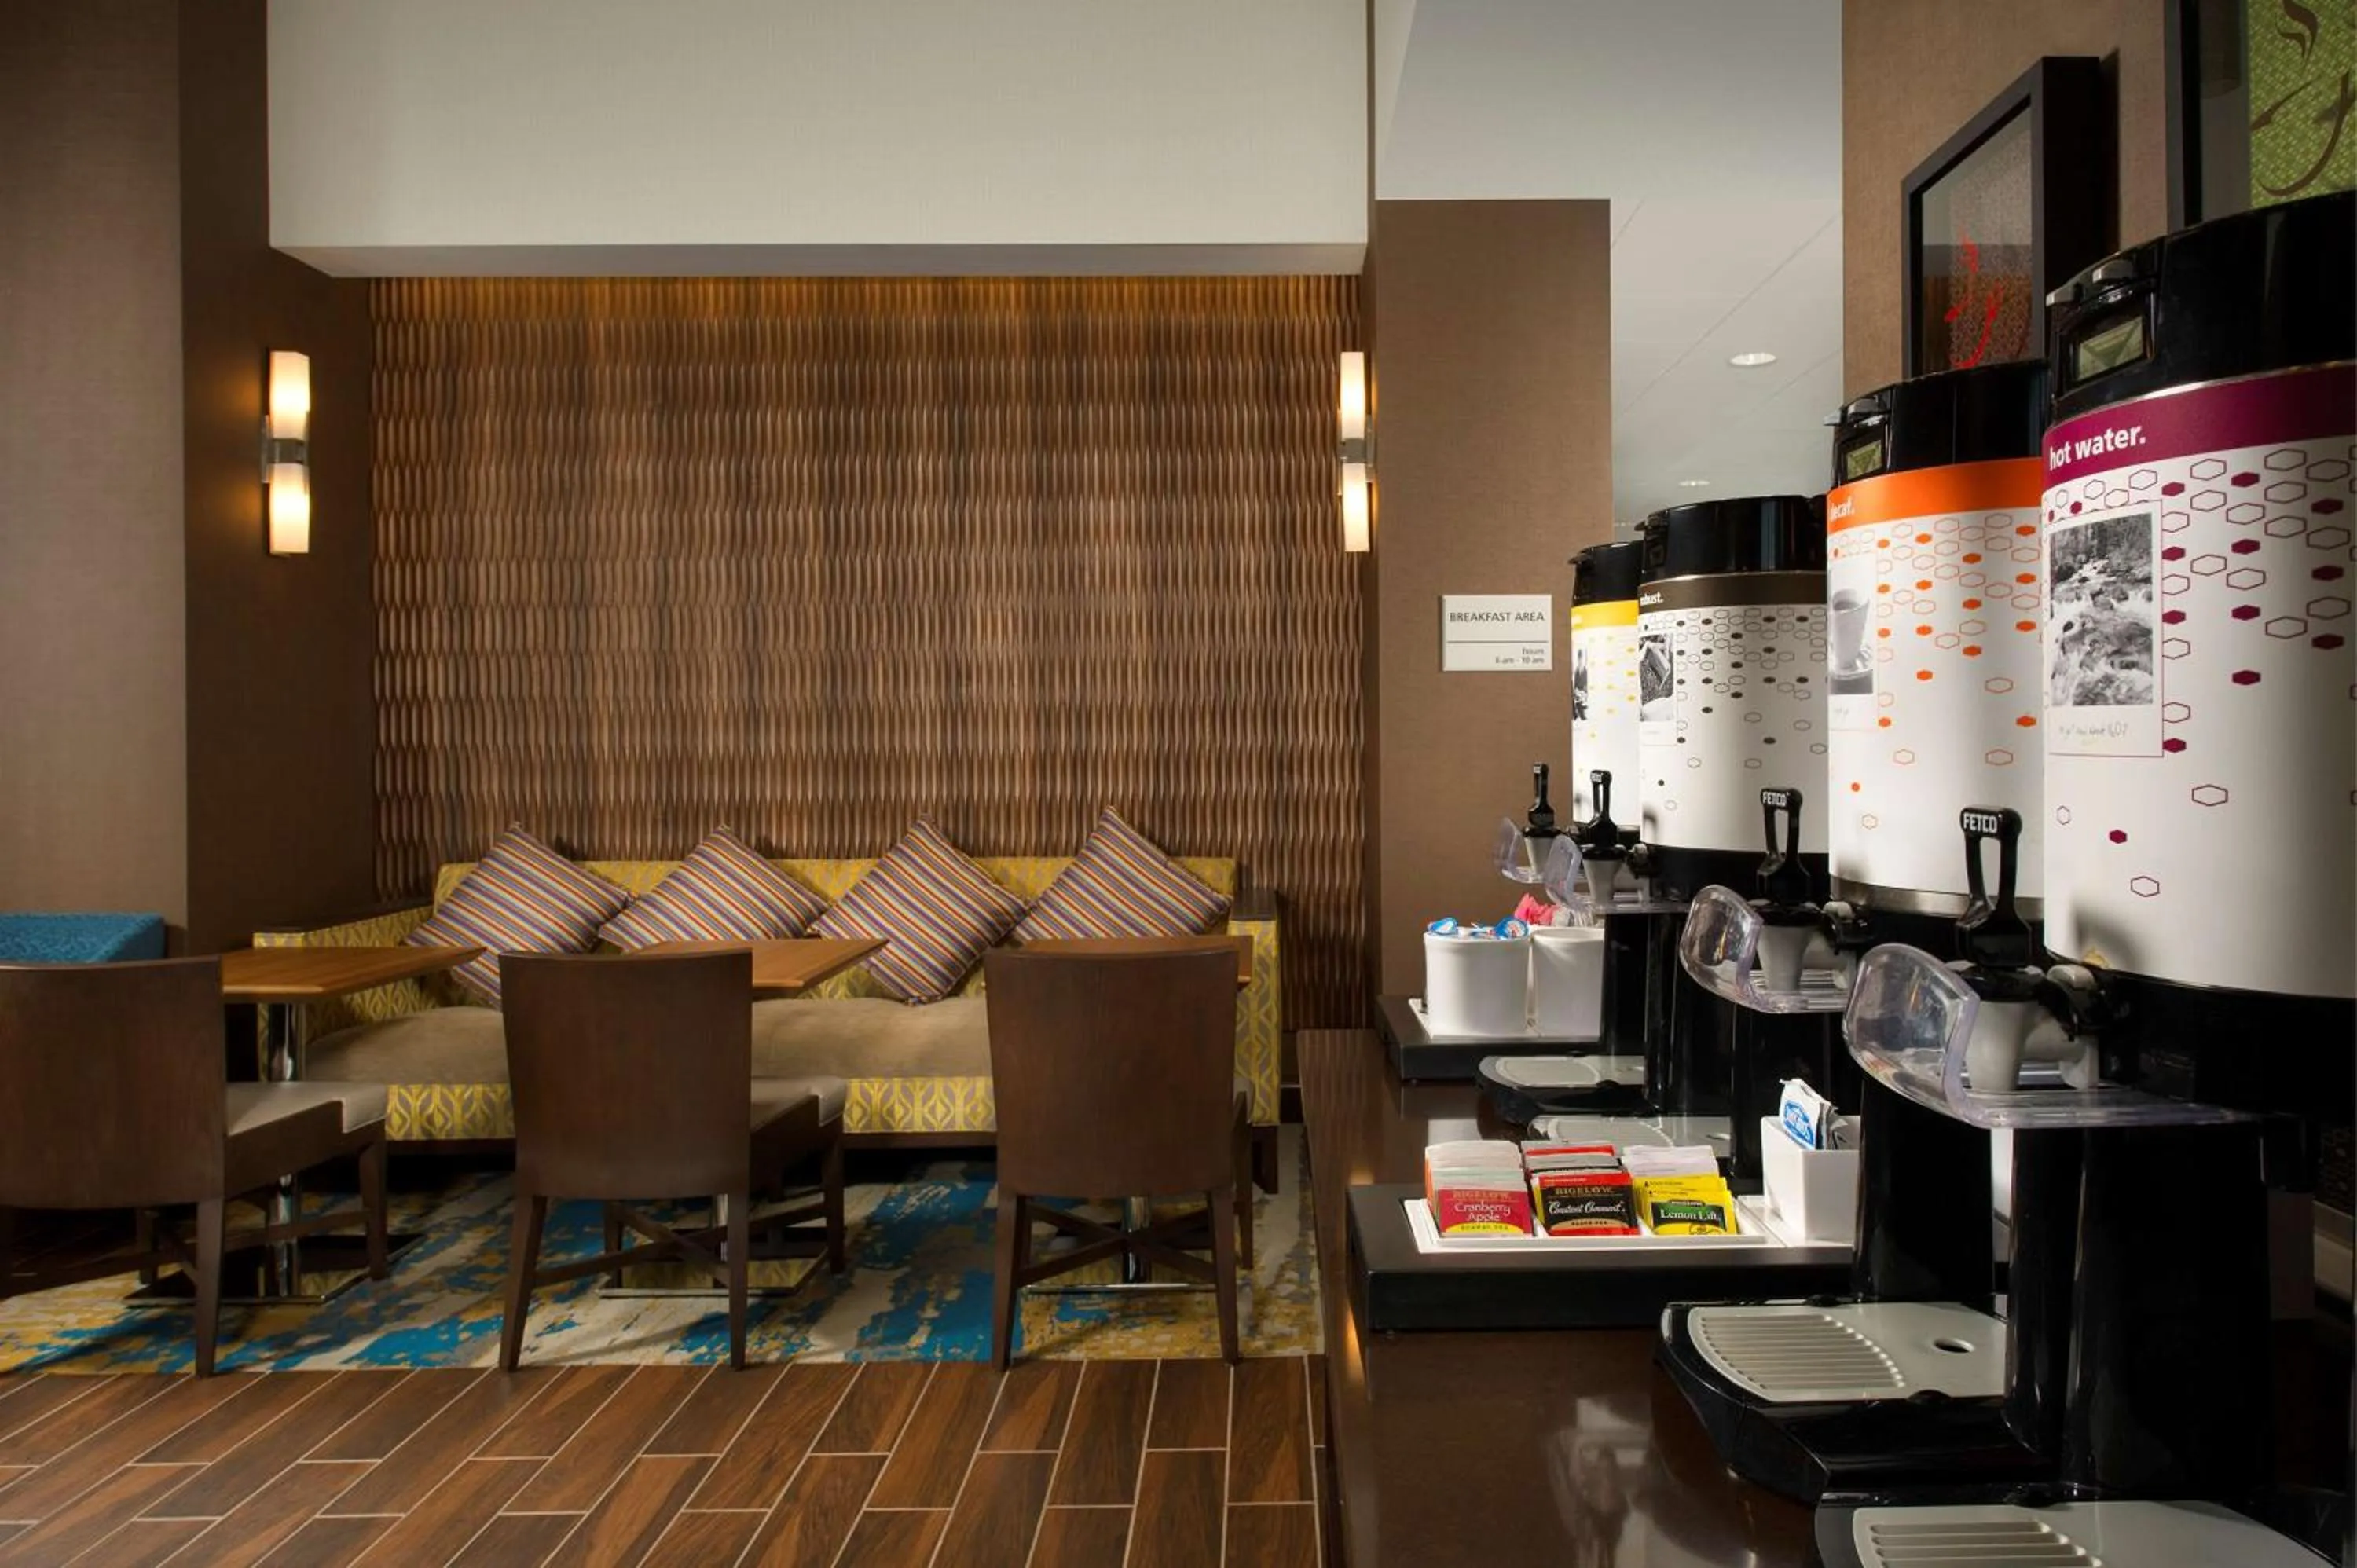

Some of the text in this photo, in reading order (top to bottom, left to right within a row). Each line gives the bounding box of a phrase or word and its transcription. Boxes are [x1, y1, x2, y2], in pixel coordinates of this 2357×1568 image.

[2049, 425, 2146, 471] hot water.
[1450, 612, 1545, 623] BREAKFAST AREA
[1963, 812, 1998, 833] FETCO
[1454, 1200, 1511, 1216] Cranberry
[1660, 1208, 1697, 1220] Lemon
[1467, 1211, 1500, 1225] Apple
